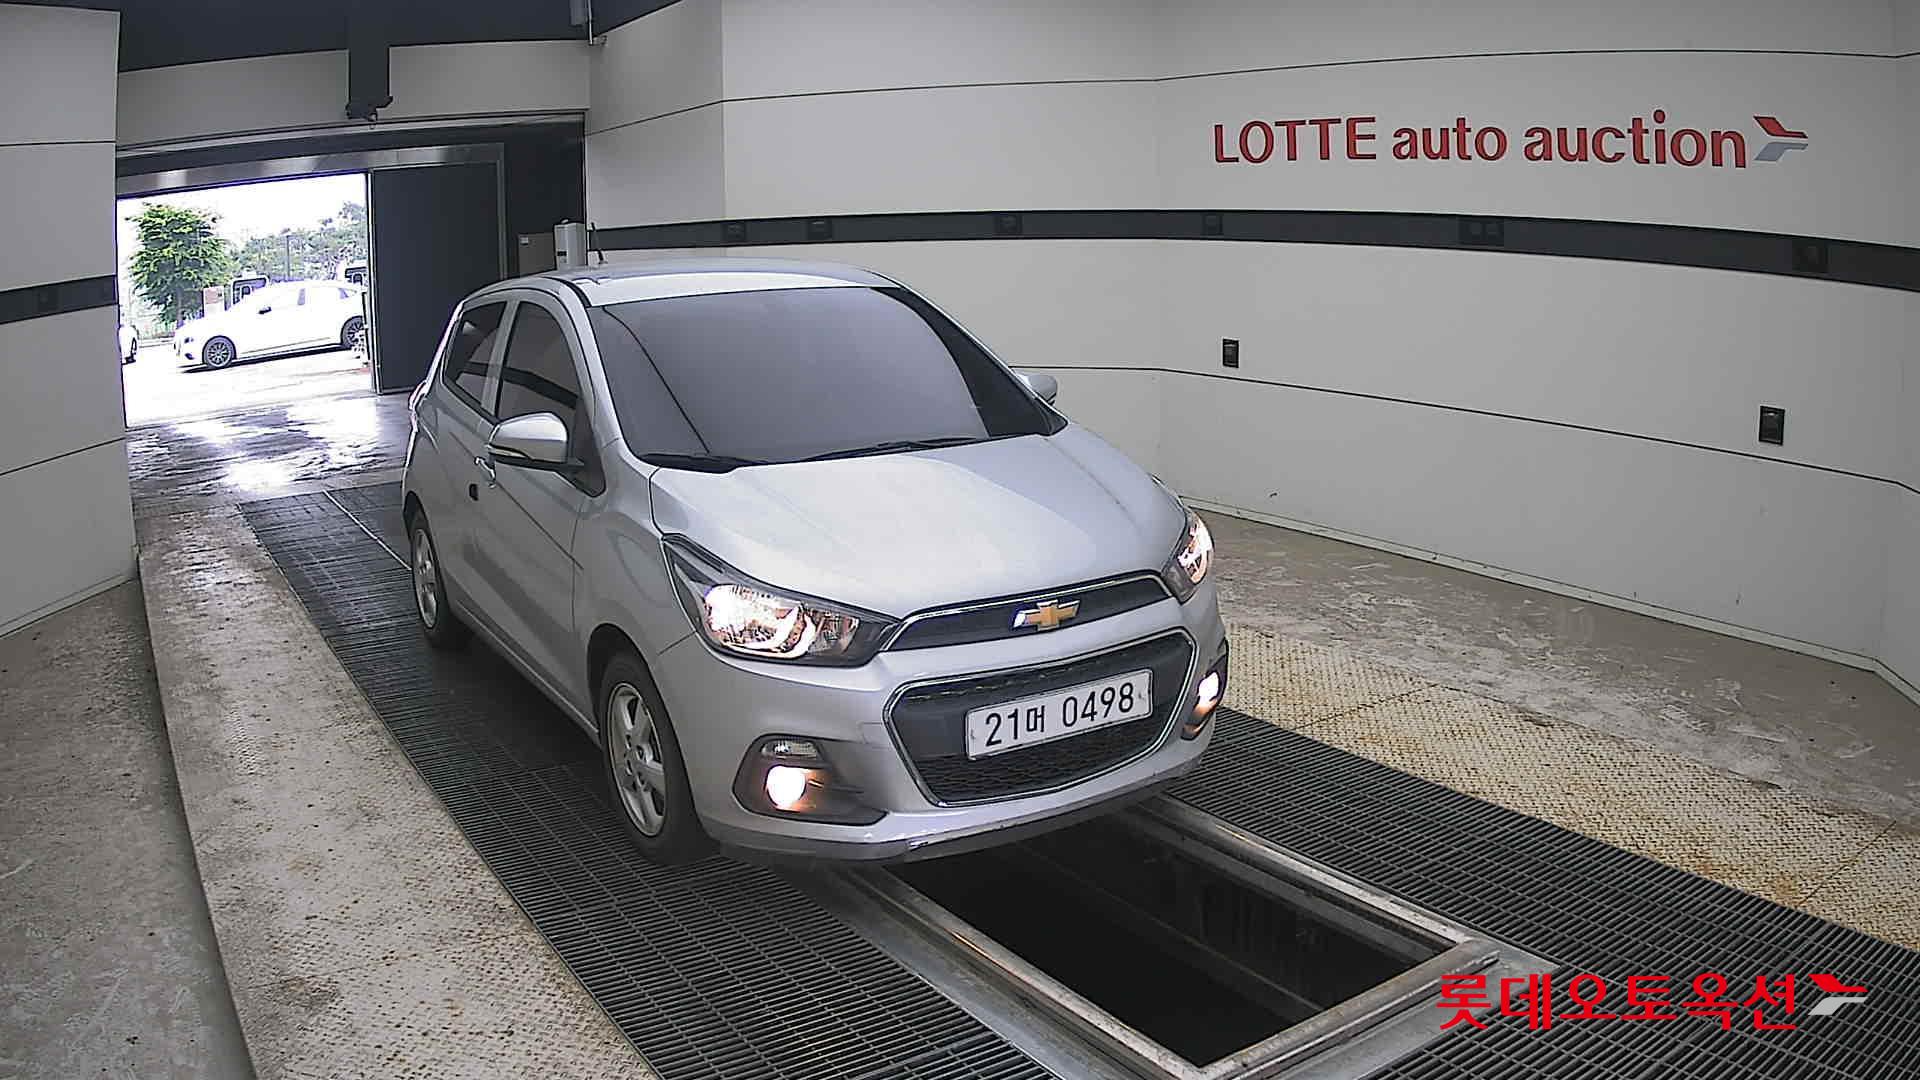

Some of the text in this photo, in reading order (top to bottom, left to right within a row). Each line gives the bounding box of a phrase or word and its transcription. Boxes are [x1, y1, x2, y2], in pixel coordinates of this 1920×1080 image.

[1213, 109, 1747, 168] LOTTE auto auction
[985, 682, 1134, 747] 21머 0498
